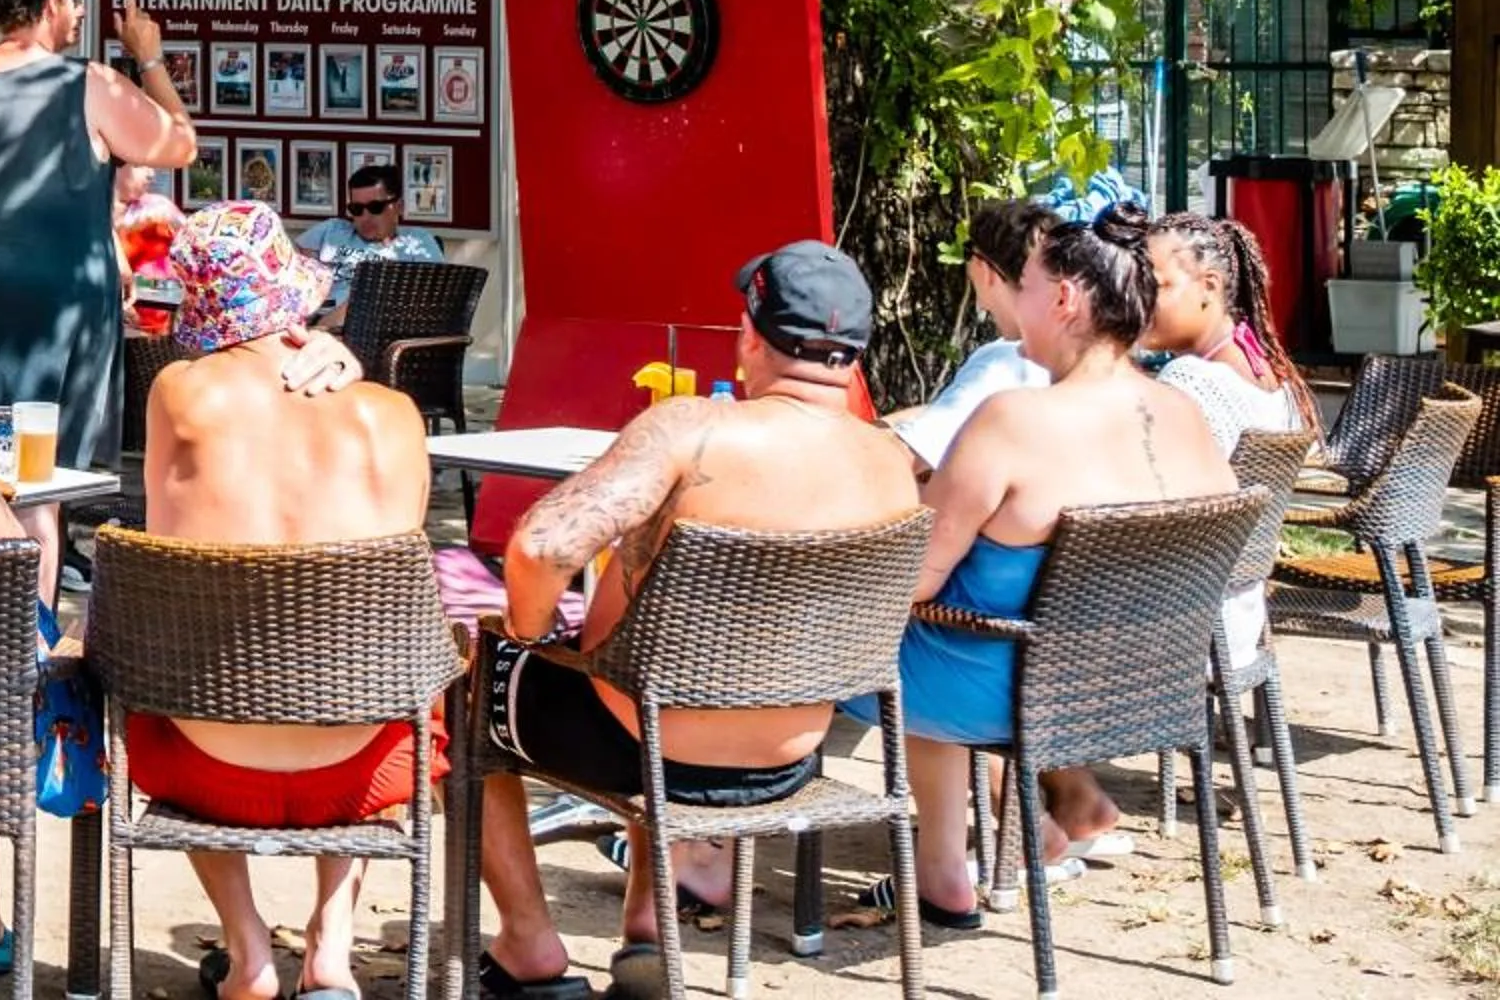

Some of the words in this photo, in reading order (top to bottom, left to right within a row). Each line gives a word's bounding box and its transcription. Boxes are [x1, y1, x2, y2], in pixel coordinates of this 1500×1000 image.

[166, 19, 198, 32] Tuesday
[211, 20, 259, 34] Wednesday
[270, 21, 309, 35] Thursday
[331, 21, 359, 36] Friday
[381, 23, 421, 38] Saturday
[443, 24, 477, 39] Sunday
